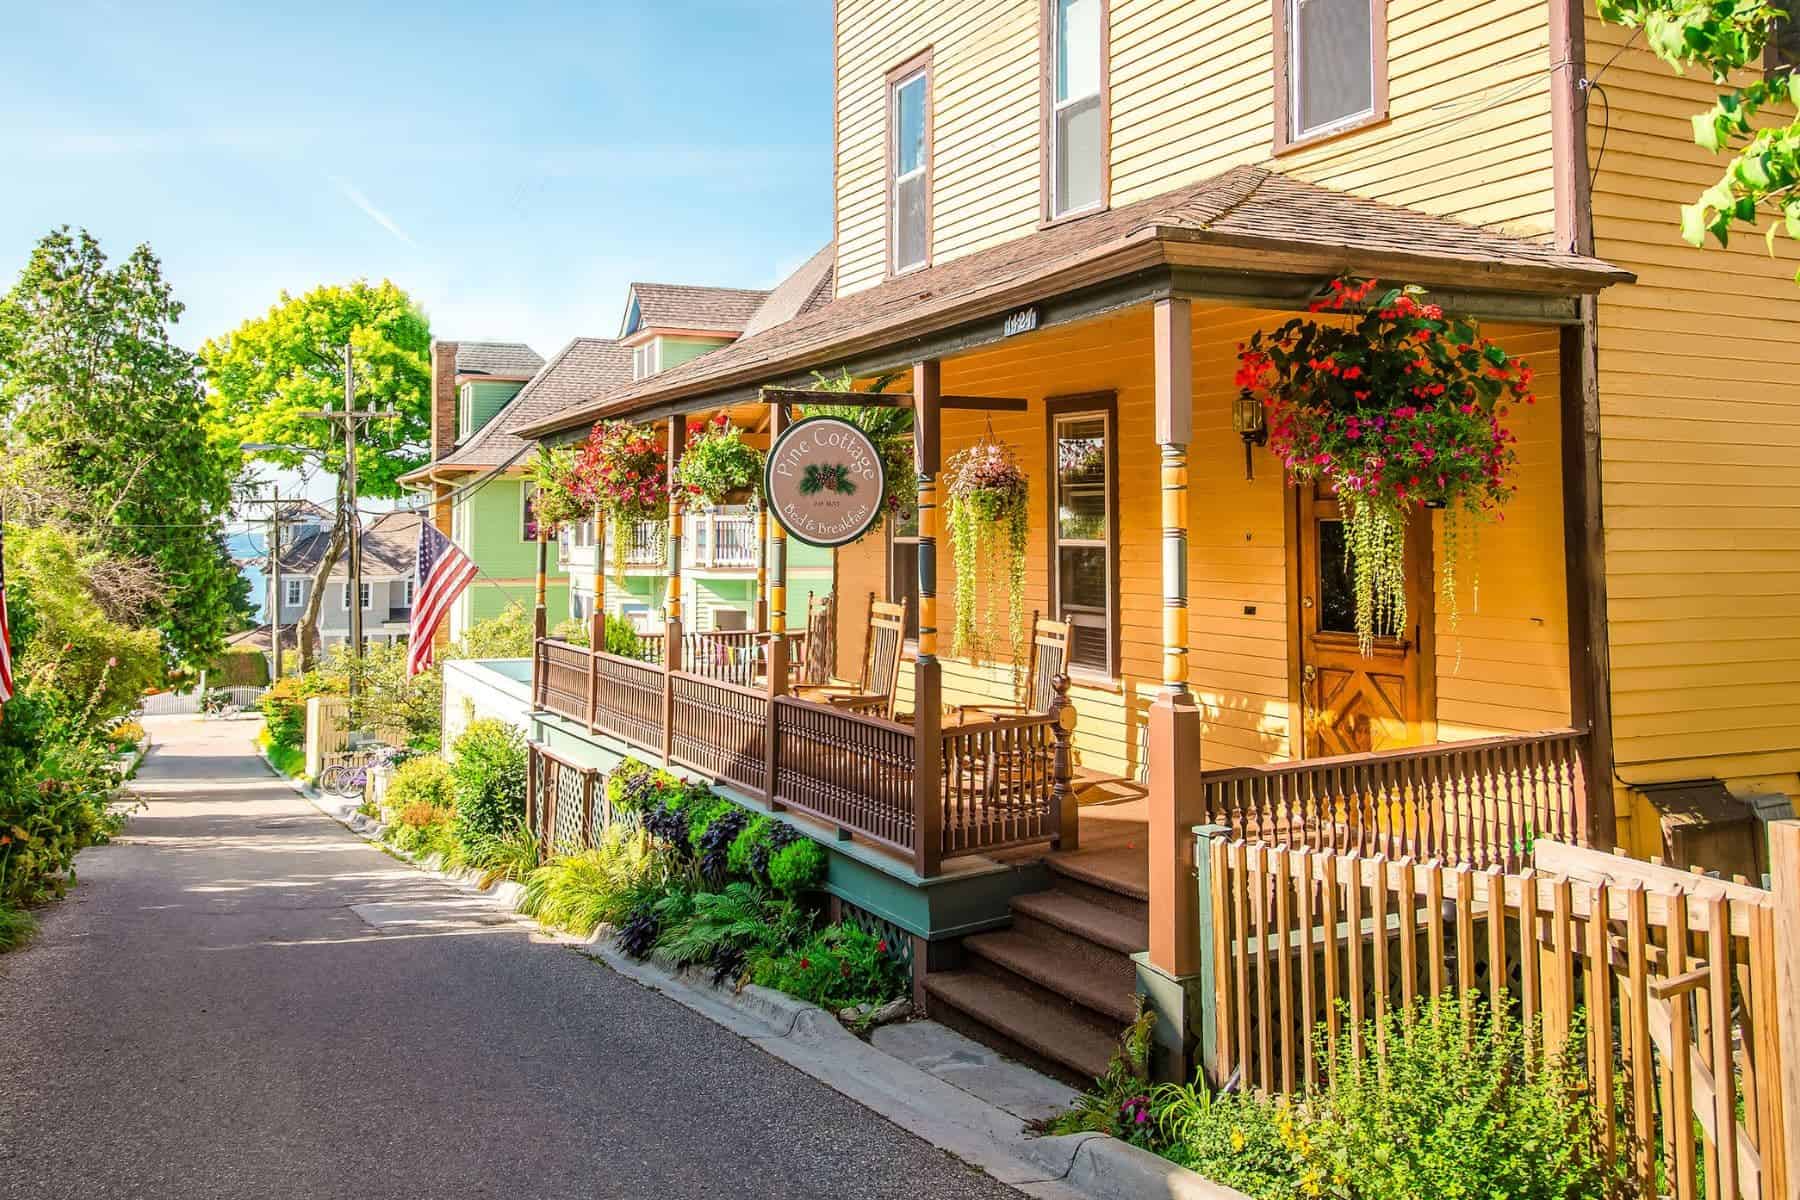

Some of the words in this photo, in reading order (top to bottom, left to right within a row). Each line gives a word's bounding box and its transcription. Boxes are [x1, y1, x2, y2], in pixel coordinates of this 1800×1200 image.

[777, 440, 809, 477] Pine
[814, 427, 874, 480] Cottage
[783, 503, 808, 527] Bed
[805, 519, 816, 531] &
[818, 504, 868, 534] Breakfast
